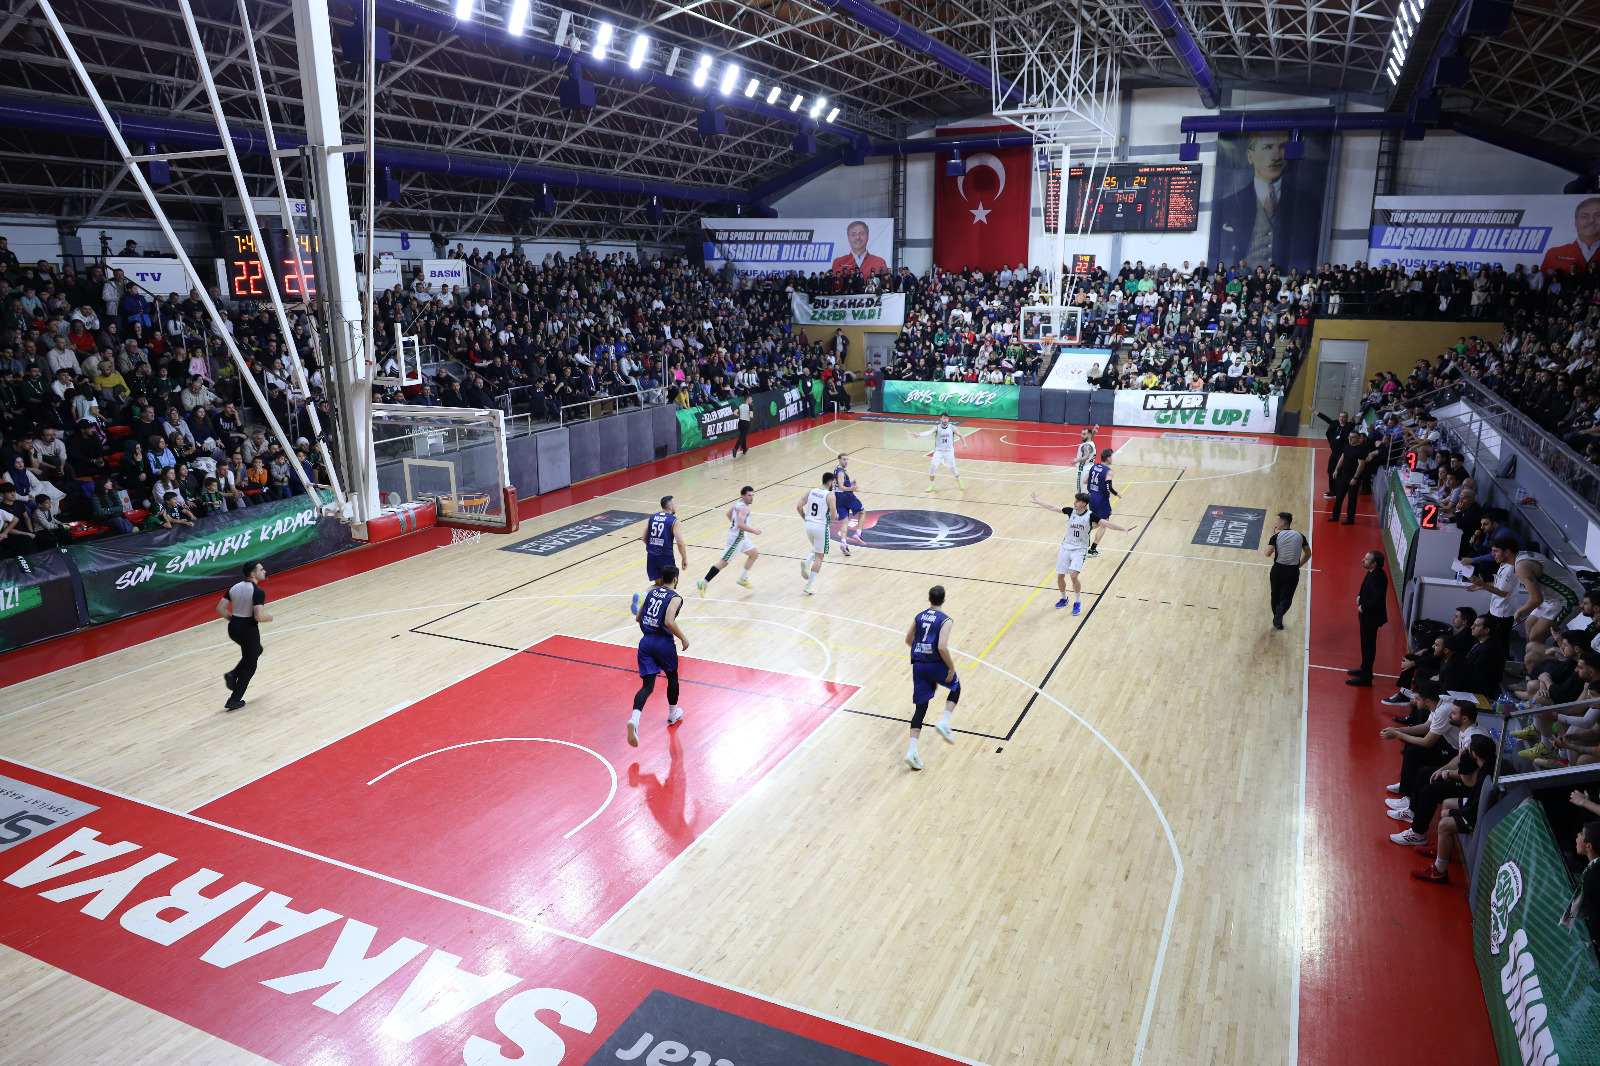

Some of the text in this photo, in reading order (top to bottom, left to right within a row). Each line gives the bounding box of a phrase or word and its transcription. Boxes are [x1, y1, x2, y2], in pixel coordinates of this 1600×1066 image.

[1103, 176, 1117, 187] 25
[1133, 175, 1147, 186] 24
[430, 270, 461, 278] BASIN
[1075, 262, 1088, 273] 22
[136, 272, 162, 282] TV
[233, 260, 263, 295] 22
[810, 310, 847, 321] ZAFER
[904, 389, 998, 406] BOYS OF RIVER
[1145, 394, 1205, 410] NEVER
[1154, 408, 1252, 427] GIVE UP!
[1406, 452, 1416, 470] 3
[811, 502, 819, 517] 9
[1422, 504, 1437, 528] 2
[651, 521, 665, 538] 59
[115, 562, 157, 590] SON
[646, 597, 663, 617] 20
[922, 622, 932, 642] 7
[1, 826, 598, 1066] SAKARYA
